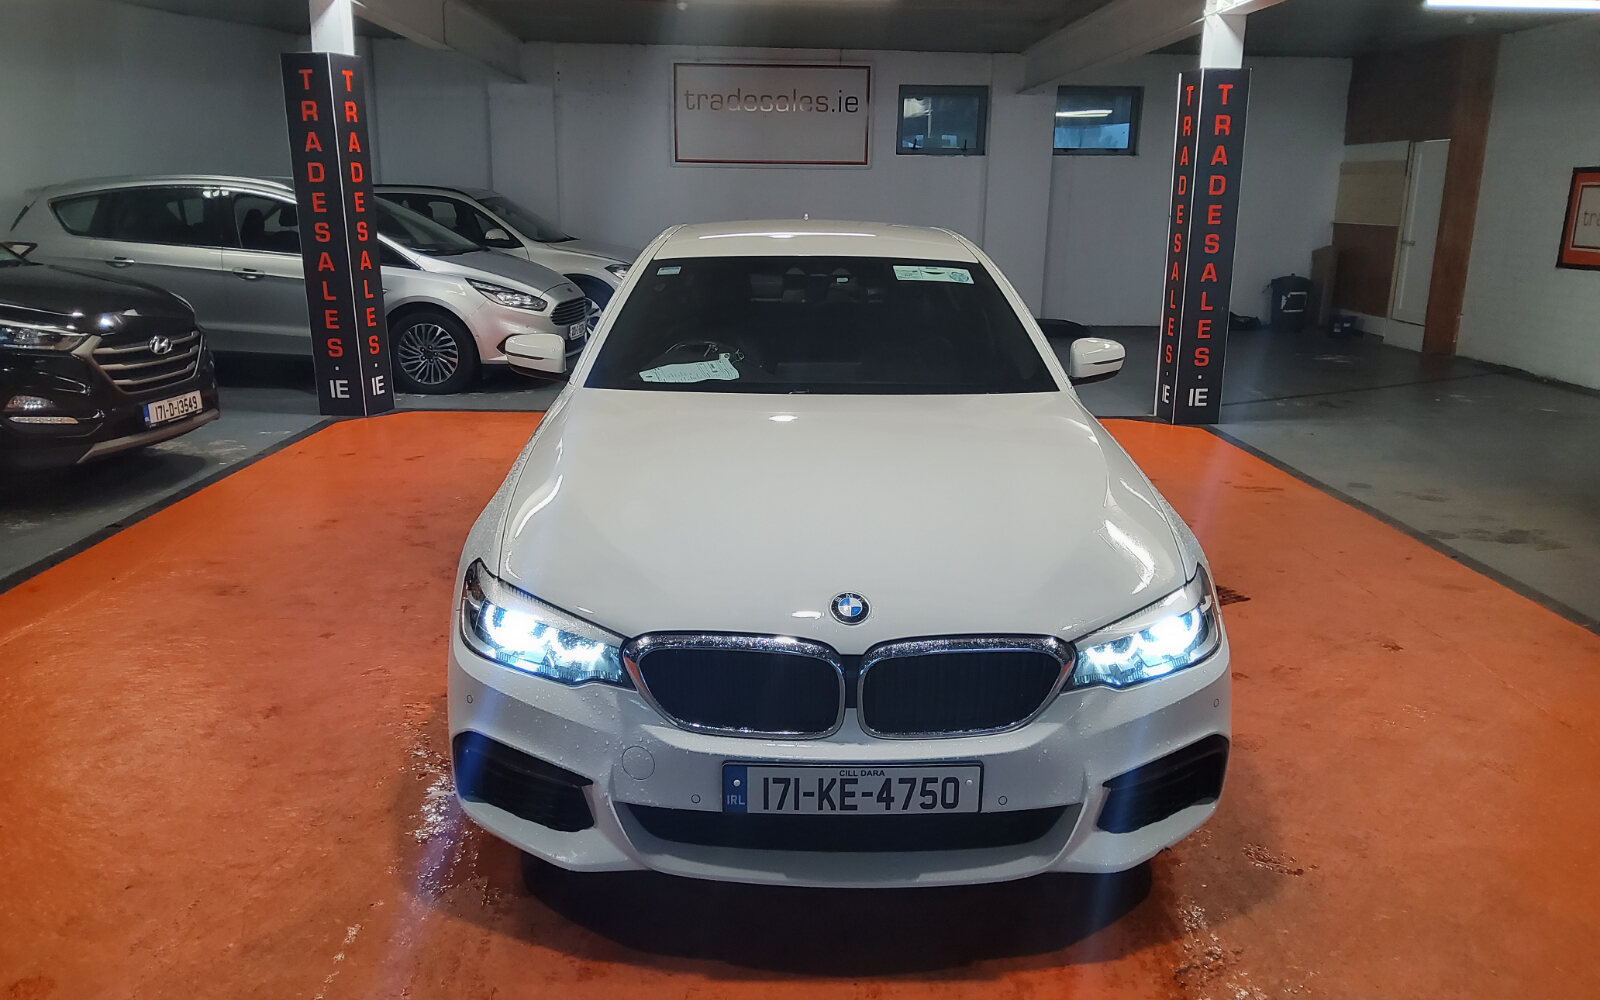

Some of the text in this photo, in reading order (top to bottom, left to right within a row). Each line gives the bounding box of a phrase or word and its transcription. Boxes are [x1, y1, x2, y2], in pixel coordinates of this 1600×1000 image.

[684, 87, 859, 113] tradesales.ie
[155, 395, 198, 421] 171-D-13549
[839, 769, 885, 777] CILL DARA
[726, 794, 746, 806] IRL
[762, 776, 960, 811] 171-KE-4750
